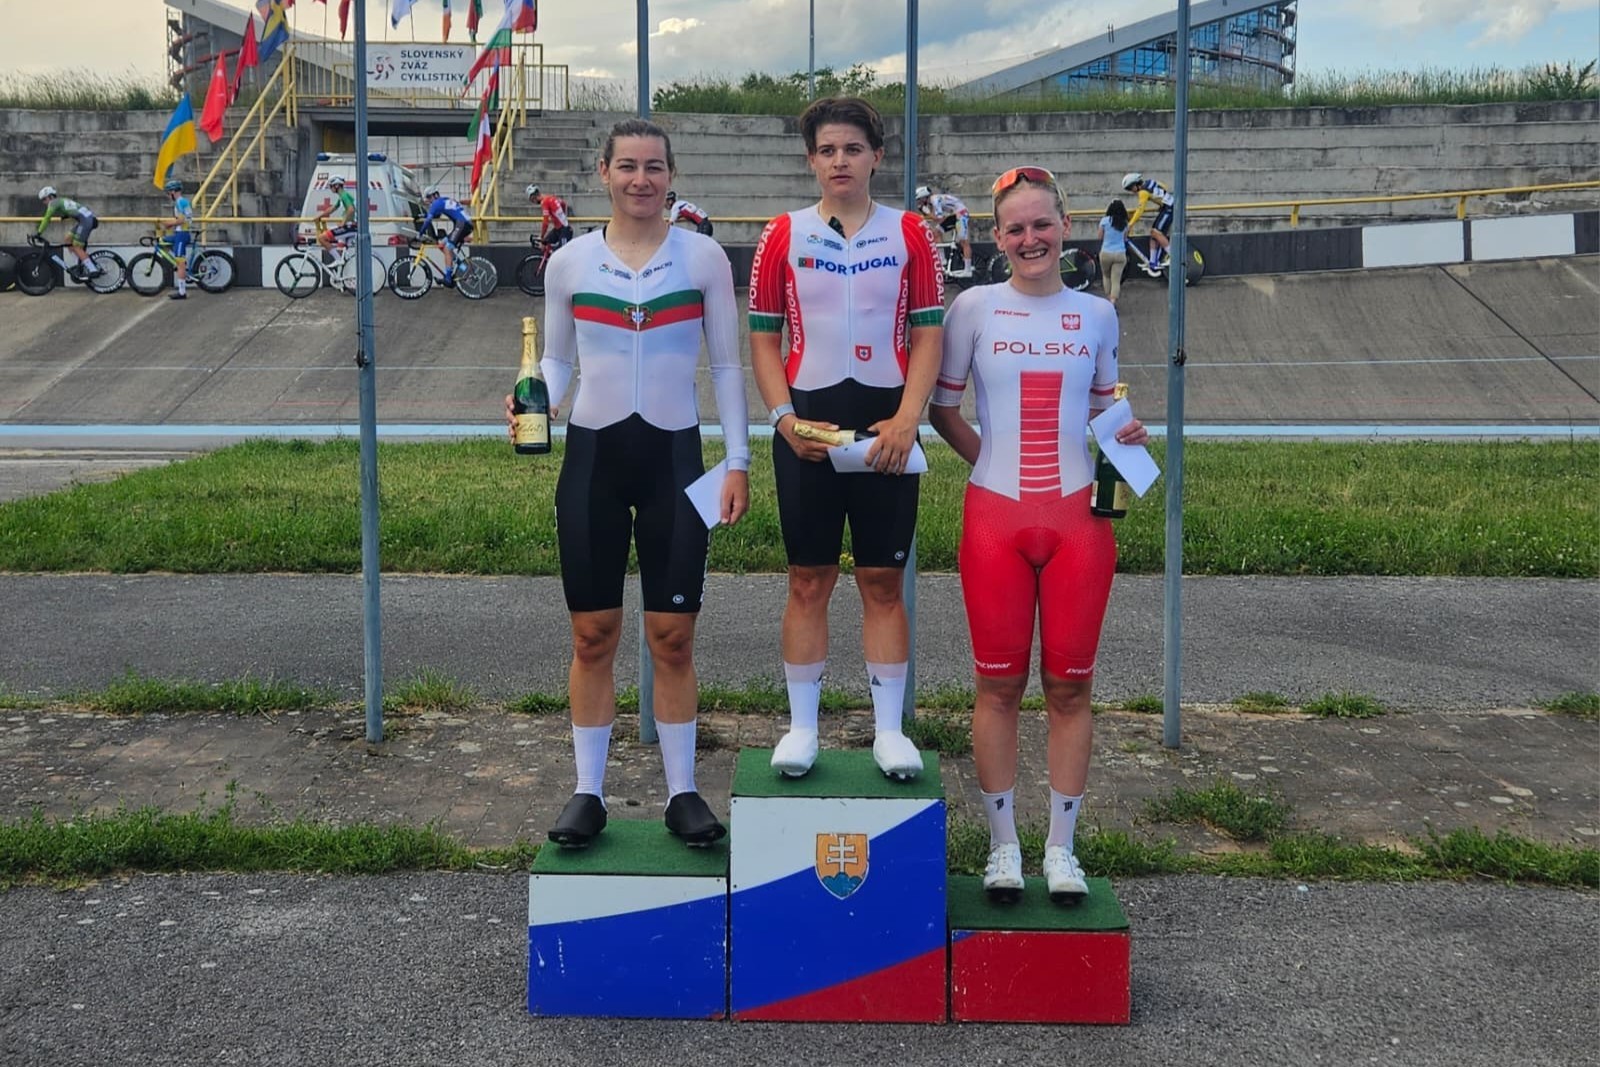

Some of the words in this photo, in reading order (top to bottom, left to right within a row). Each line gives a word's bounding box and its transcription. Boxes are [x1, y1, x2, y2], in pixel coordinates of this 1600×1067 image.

[400, 48, 464, 59] SLOVENSKÝ
[400, 73, 465, 81] CYKLISTIKY
[748, 222, 777, 309] PORTUGAL
[815, 256, 899, 276] PORTUGAL
[918, 220, 945, 304] PORTUGAL
[786, 280, 801, 354] PORTUGAL
[993, 341, 1091, 358] POLSKA
